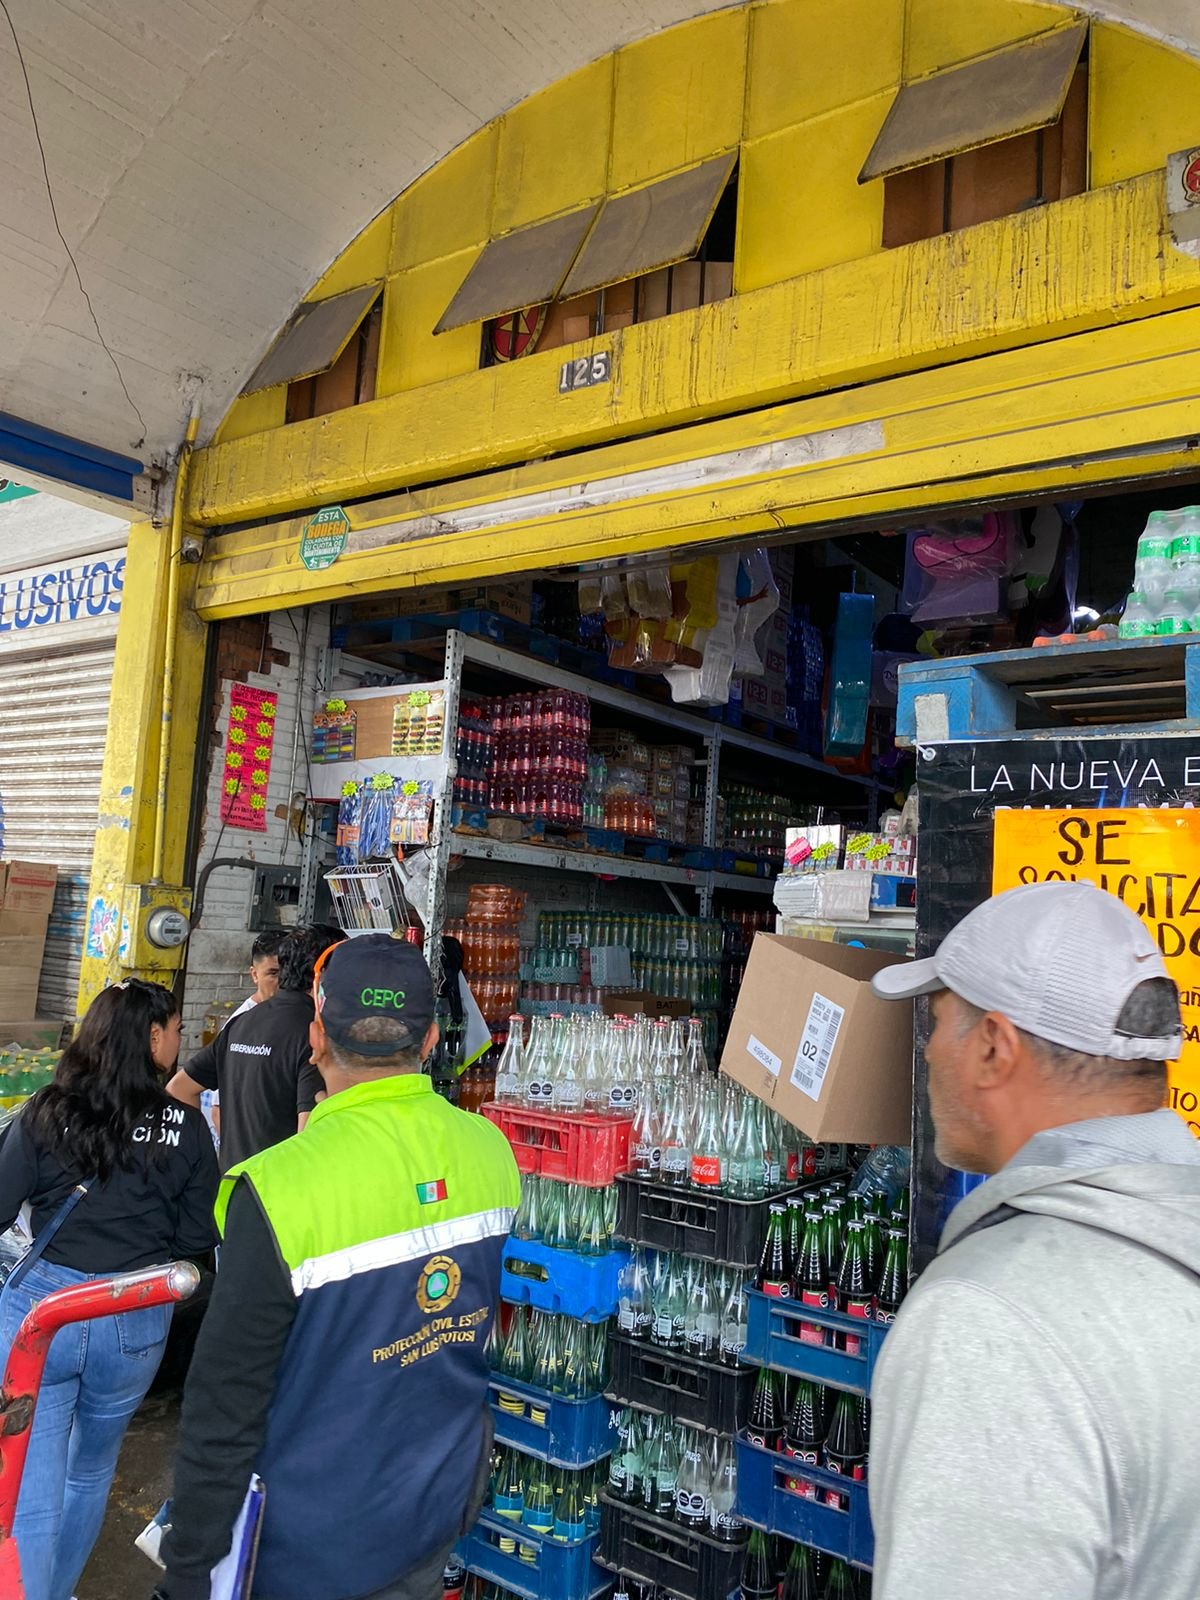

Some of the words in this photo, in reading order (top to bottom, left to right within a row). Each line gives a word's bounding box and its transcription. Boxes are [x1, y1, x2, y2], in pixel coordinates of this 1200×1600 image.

[560, 352, 606, 388] 125
[318, 511, 340, 522] ESTA
[307, 521, 346, 539] BODEGA
[970, 764, 1014, 792] LA
[1030, 758, 1165, 791] NUEVA
[1057, 816, 1130, 866] SE
[361, 988, 405, 1009] CEPC
[802, 1041, 818, 1062] 02
[431, 1316, 455, 1332] CIVIL
[400, 1347, 420, 1367] SAN
[421, 1337, 440, 1357] LUIS
